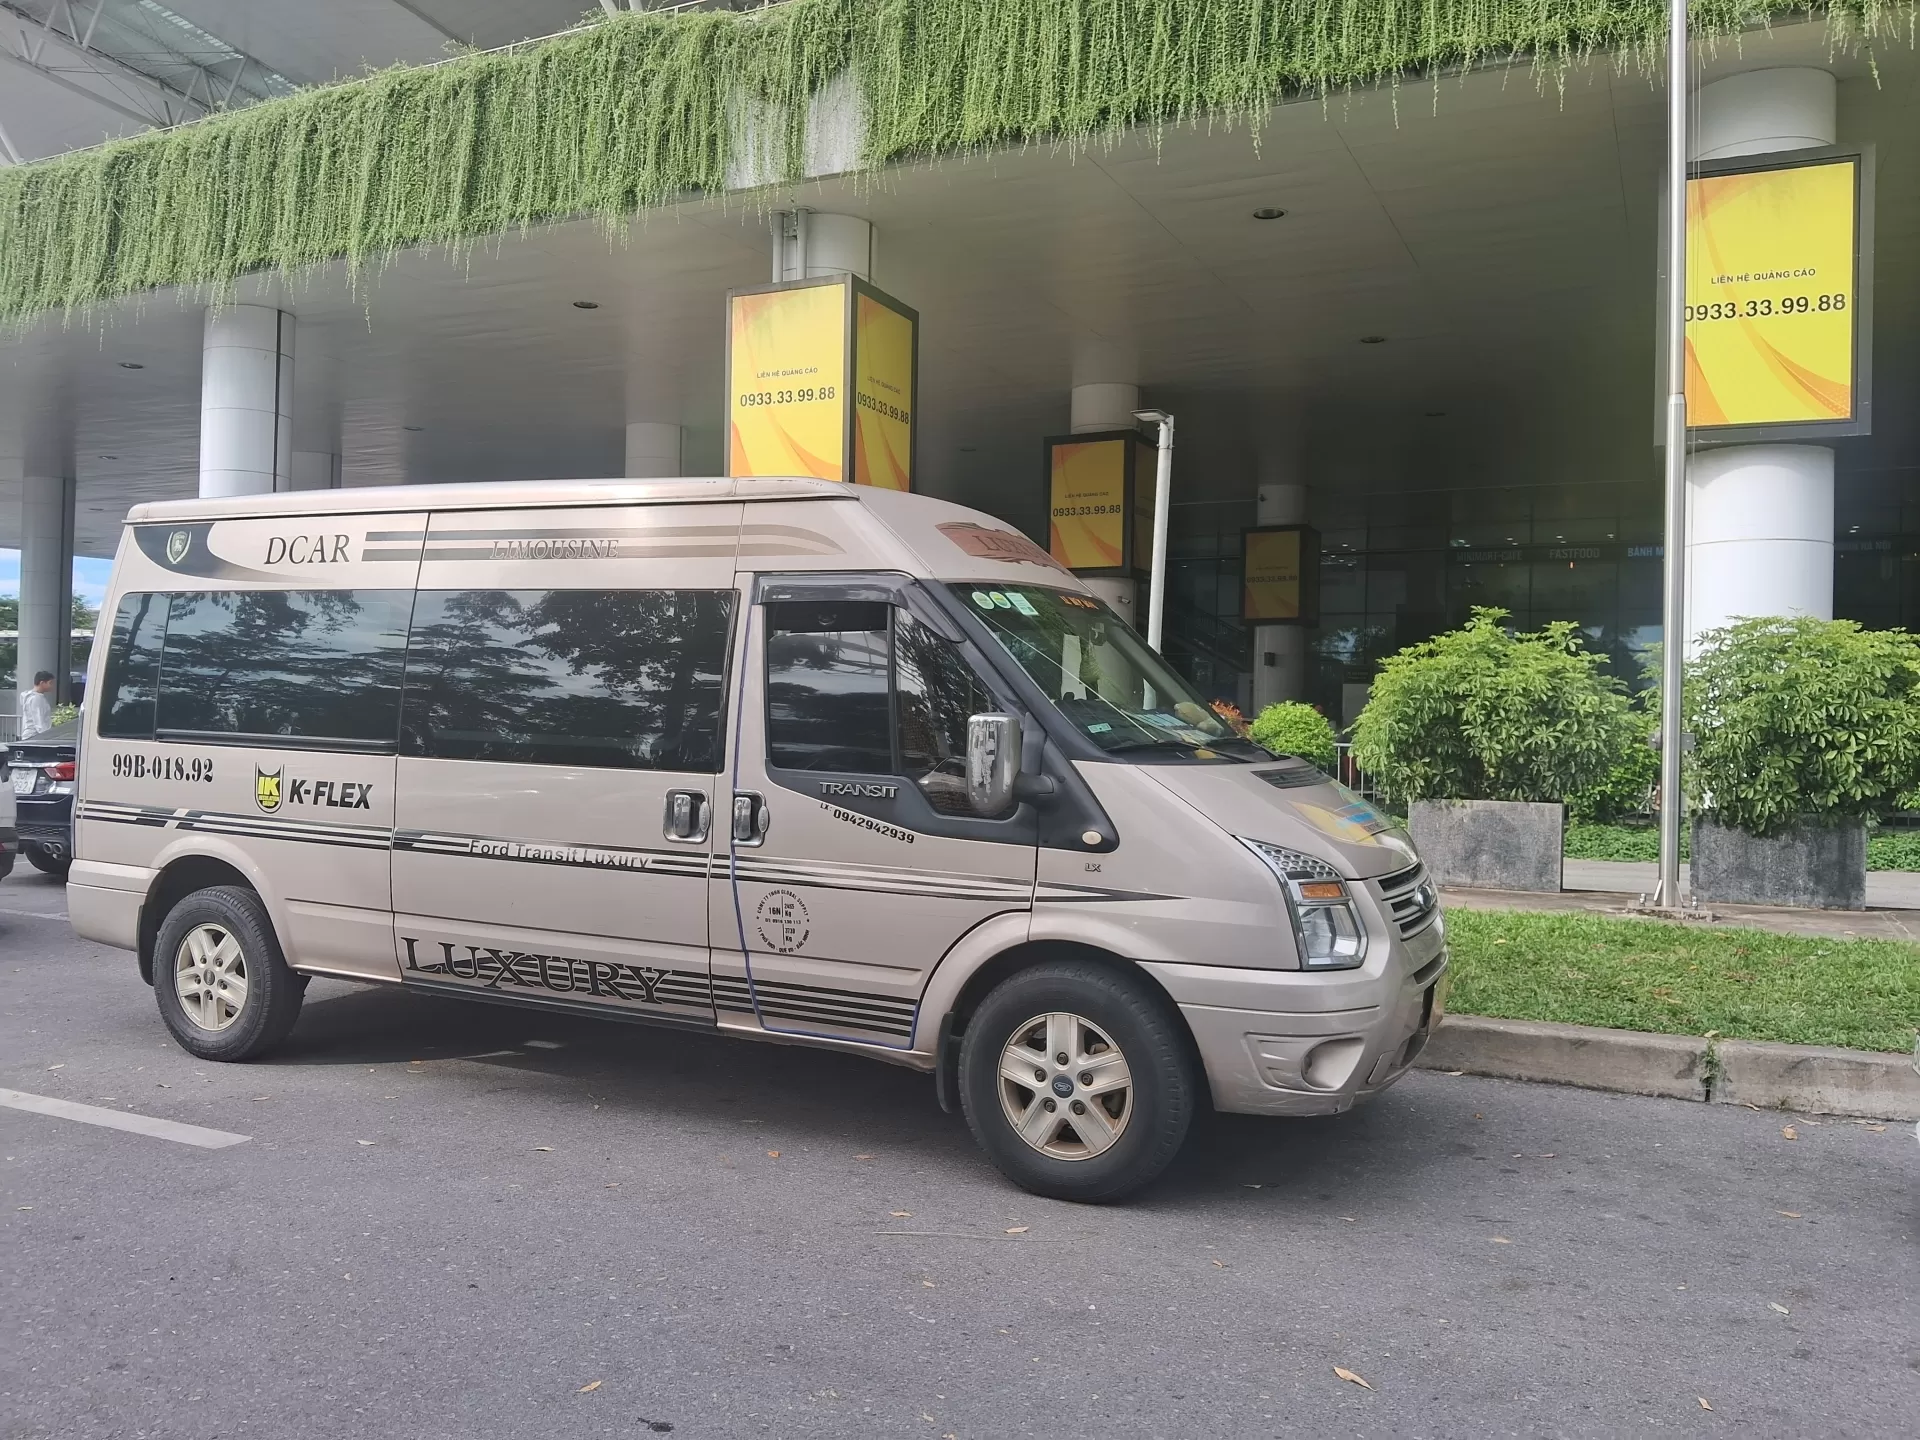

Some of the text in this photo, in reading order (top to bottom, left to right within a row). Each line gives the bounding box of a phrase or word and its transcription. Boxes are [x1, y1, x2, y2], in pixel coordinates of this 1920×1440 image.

[1711, 267, 1816, 284] LIÊN HỆ QUẢNG CÁO
[1685, 293, 1846, 322] 0933.33.99.88
[740, 386, 836, 407] 0933.33.99.88
[857, 391, 909, 425] 0933.33.99.88
[1052, 504, 1121, 517] 0933.33.99.88
[263, 534, 350, 565] DCAR
[489, 539, 619, 560] LIMOUSINE
[1549, 548, 1600, 559] FASTFOOD
[112, 753, 214, 783] 99B-018.92
[289, 779, 374, 809] K-FLEX
[820, 782, 898, 798] TRANSIT
[833, 808, 915, 844] 0942942939
[470, 839, 651, 869] Ford Transit Luxury
[781, 889, 797, 900] GLOBAL
[401, 936, 672, 1004] LUXURY
